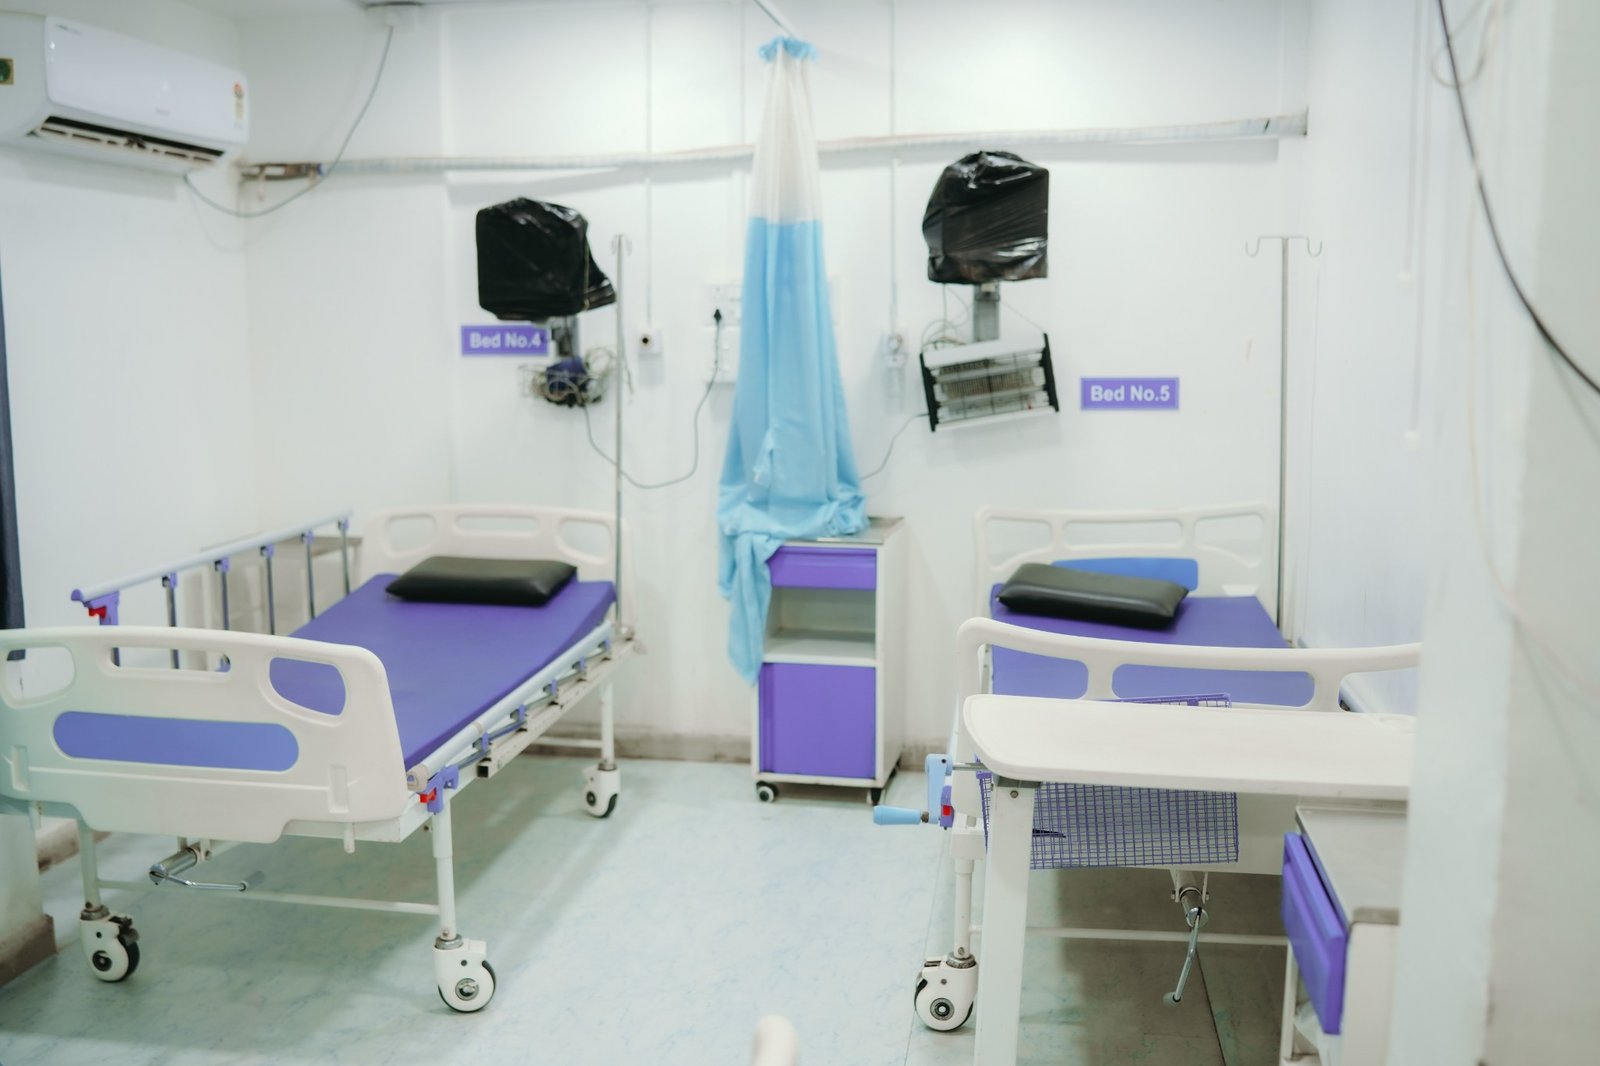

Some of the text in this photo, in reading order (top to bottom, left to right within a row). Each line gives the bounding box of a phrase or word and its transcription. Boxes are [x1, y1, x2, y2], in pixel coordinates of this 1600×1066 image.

[470, 332, 541, 348] Bed No.4
[1090, 385, 1170, 402] Bed No.5
